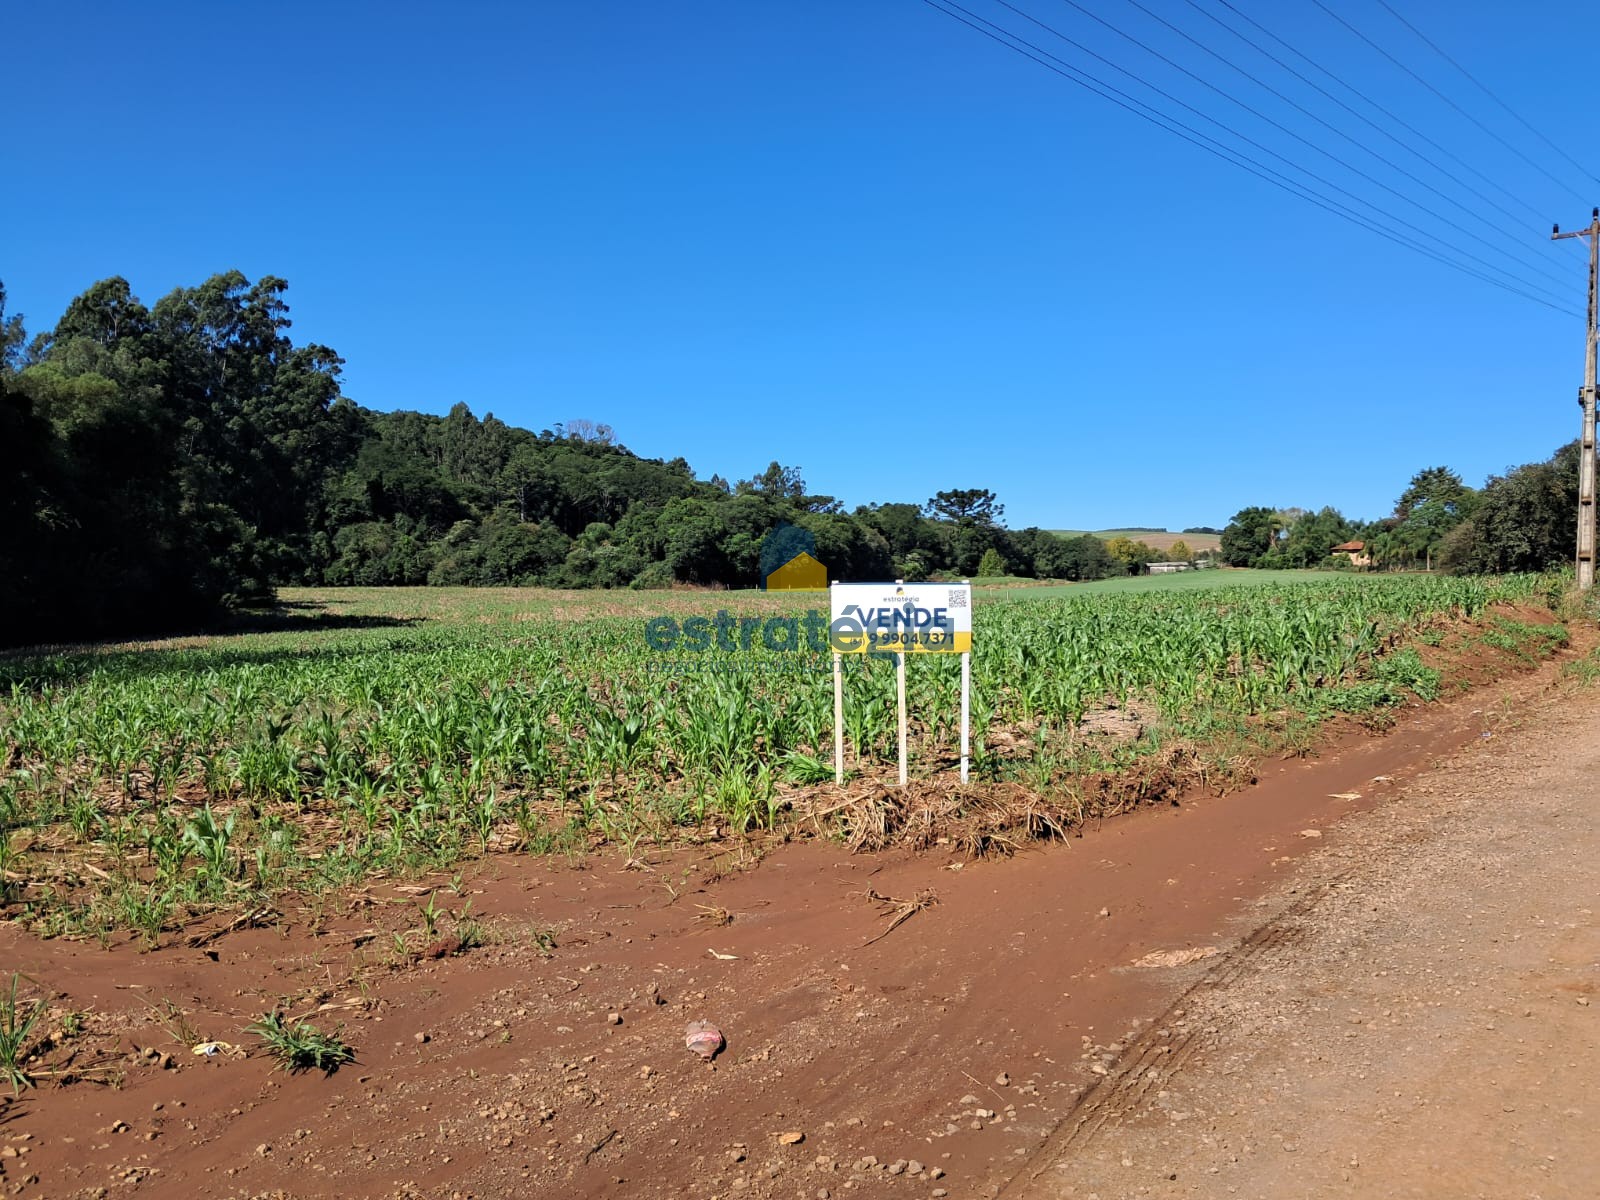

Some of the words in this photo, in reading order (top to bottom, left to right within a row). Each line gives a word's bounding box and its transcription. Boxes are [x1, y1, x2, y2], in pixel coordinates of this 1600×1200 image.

[883, 595, 920, 603] estratégia
[857, 607, 948, 628] VENDE
[869, 632, 878, 645] 9
[881, 632, 954, 645] 9904.7371
